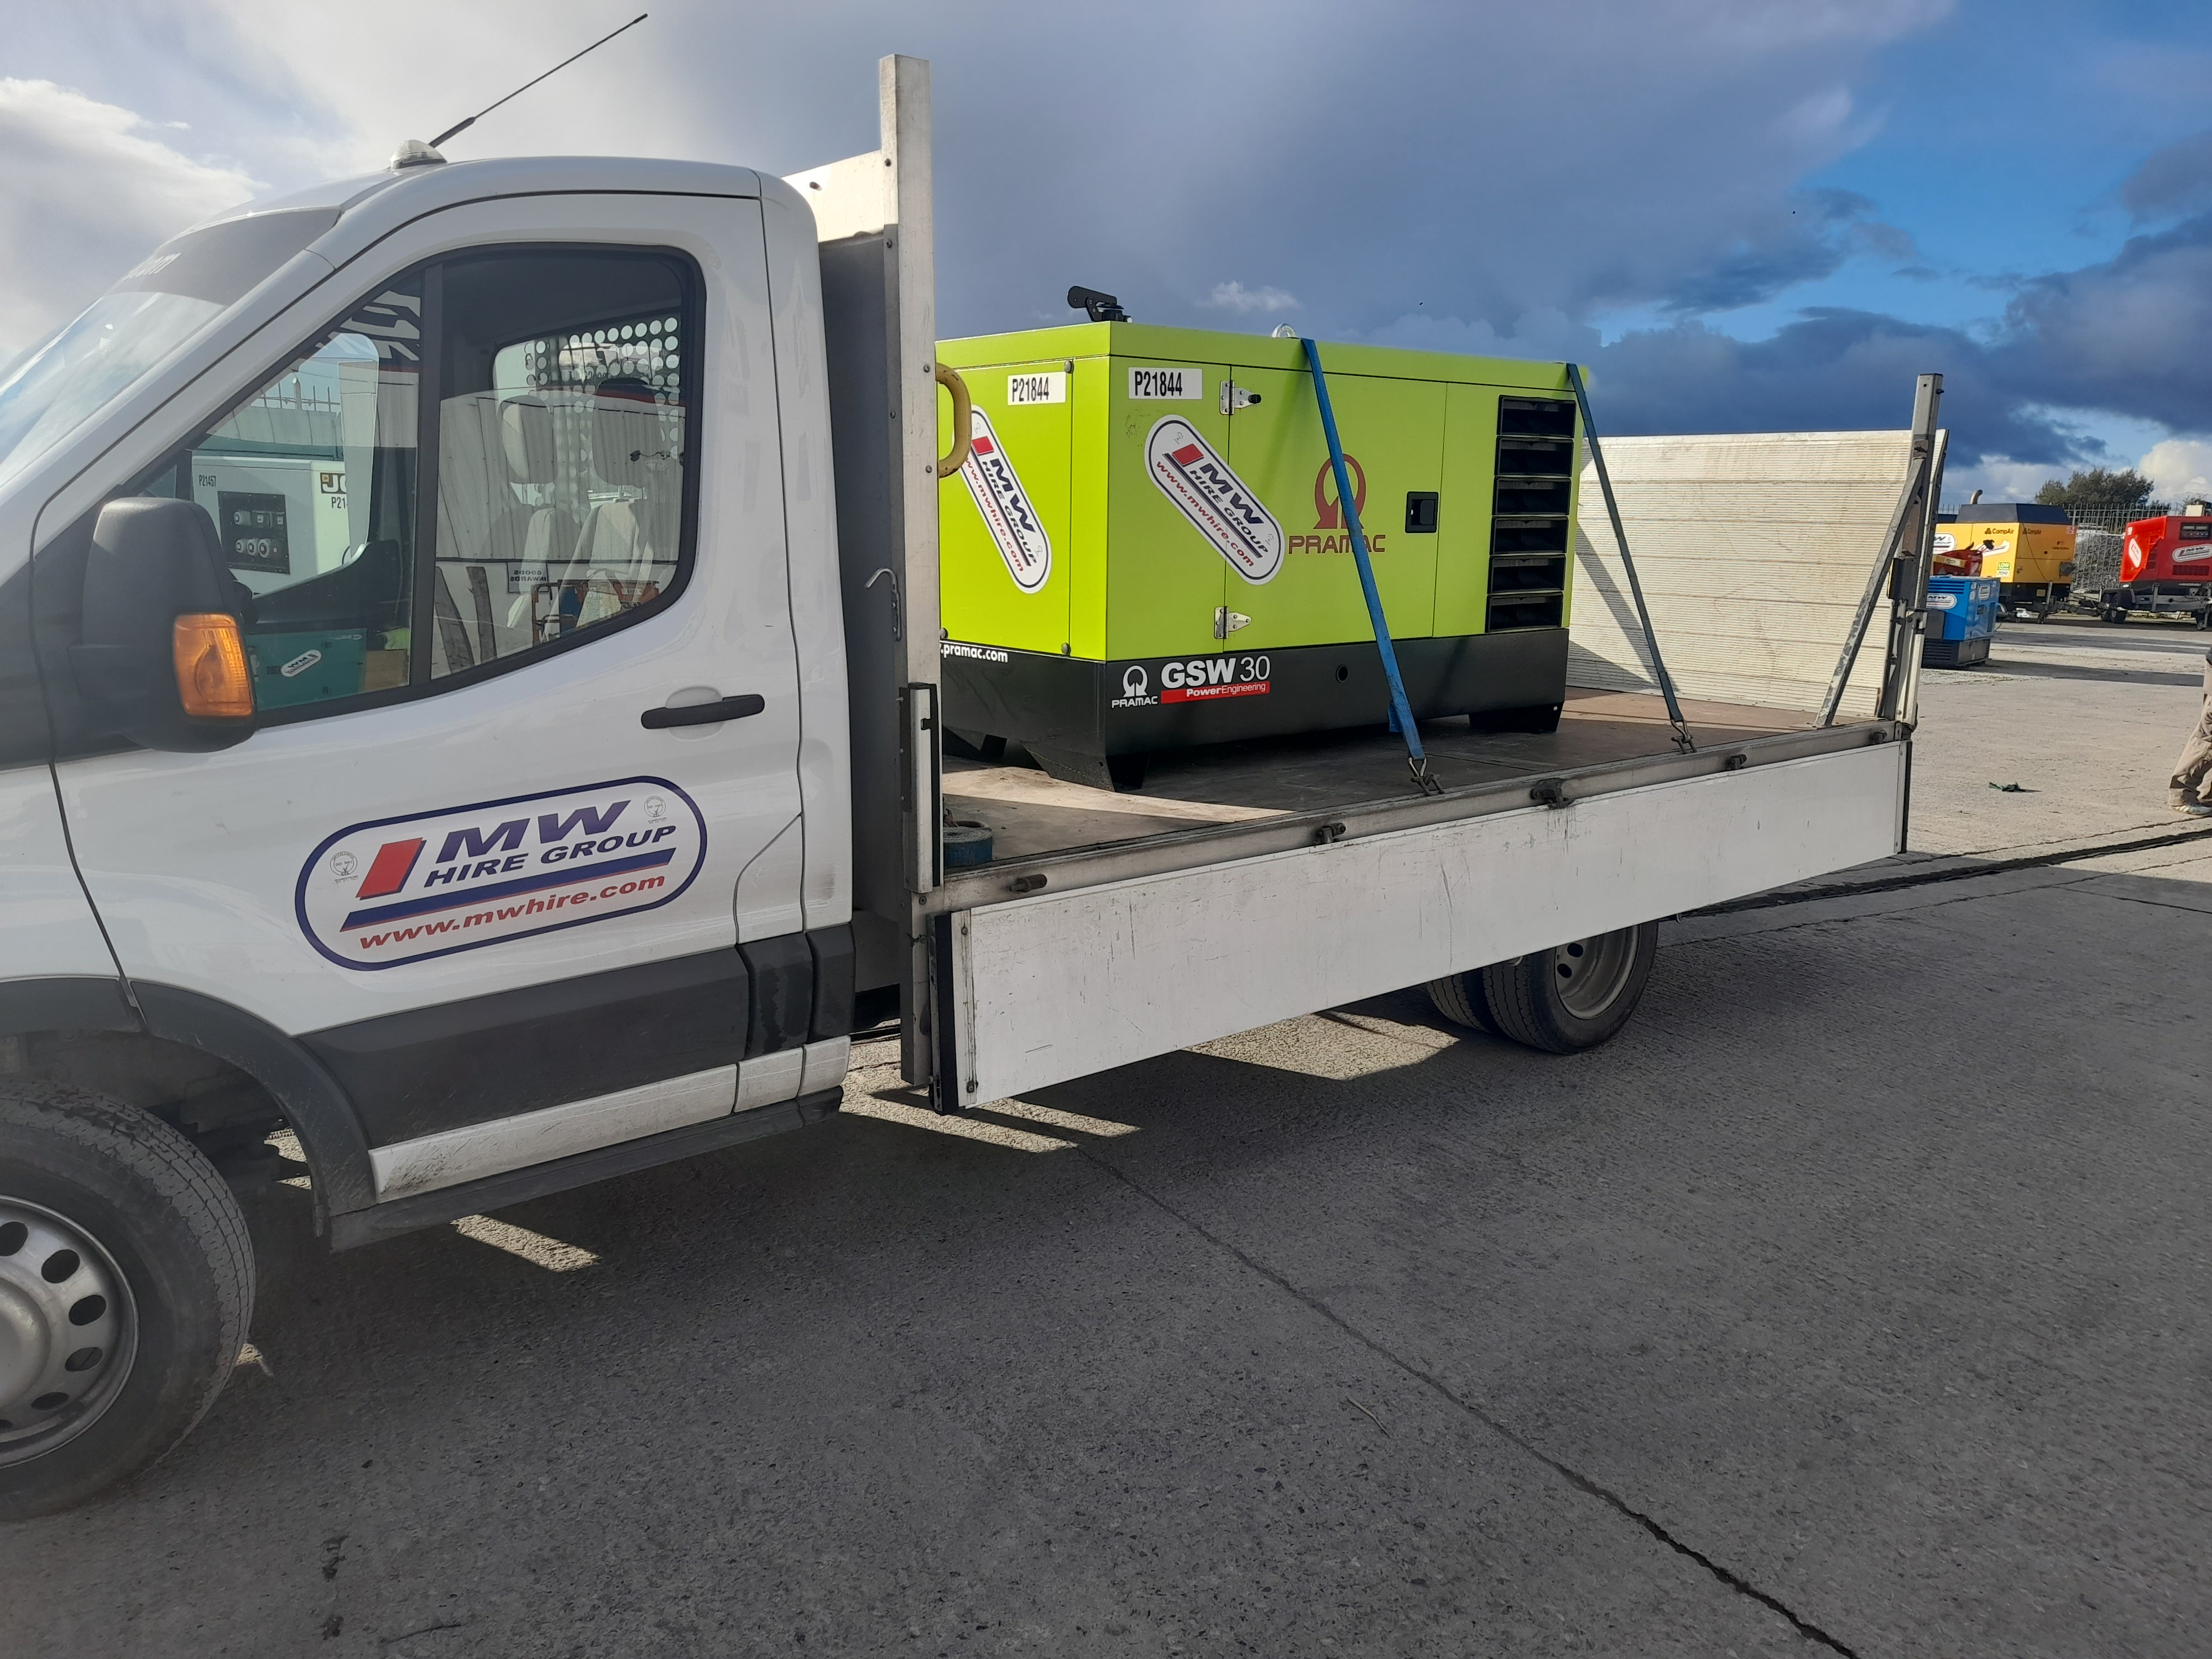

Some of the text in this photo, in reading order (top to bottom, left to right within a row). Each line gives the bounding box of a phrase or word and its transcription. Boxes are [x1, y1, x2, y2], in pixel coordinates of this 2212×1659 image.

[1011, 377, 1050, 402] P21844
[1134, 371, 1183, 397] P21844
[199, 474, 217, 487] P21457
[990, 458, 1036, 533] MW
[1189, 470, 1269, 552] HIRE GROUP
[1199, 463, 1265, 524] MW
[966, 458, 1024, 572] ww.mwhire.com
[982, 461, 1037, 564] HIRE GROUP
[1156, 461, 1254, 567] www.mwhire.com
[940, 643, 1008, 663] .pramac.com
[1161, 655, 1271, 689] GSW 30
[1112, 696, 1159, 708] PRAMAC
[424, 825, 676, 888] HIRE GROUP
[435, 800, 632, 864] MW
[359, 875, 665, 950] www.mwhire.com
